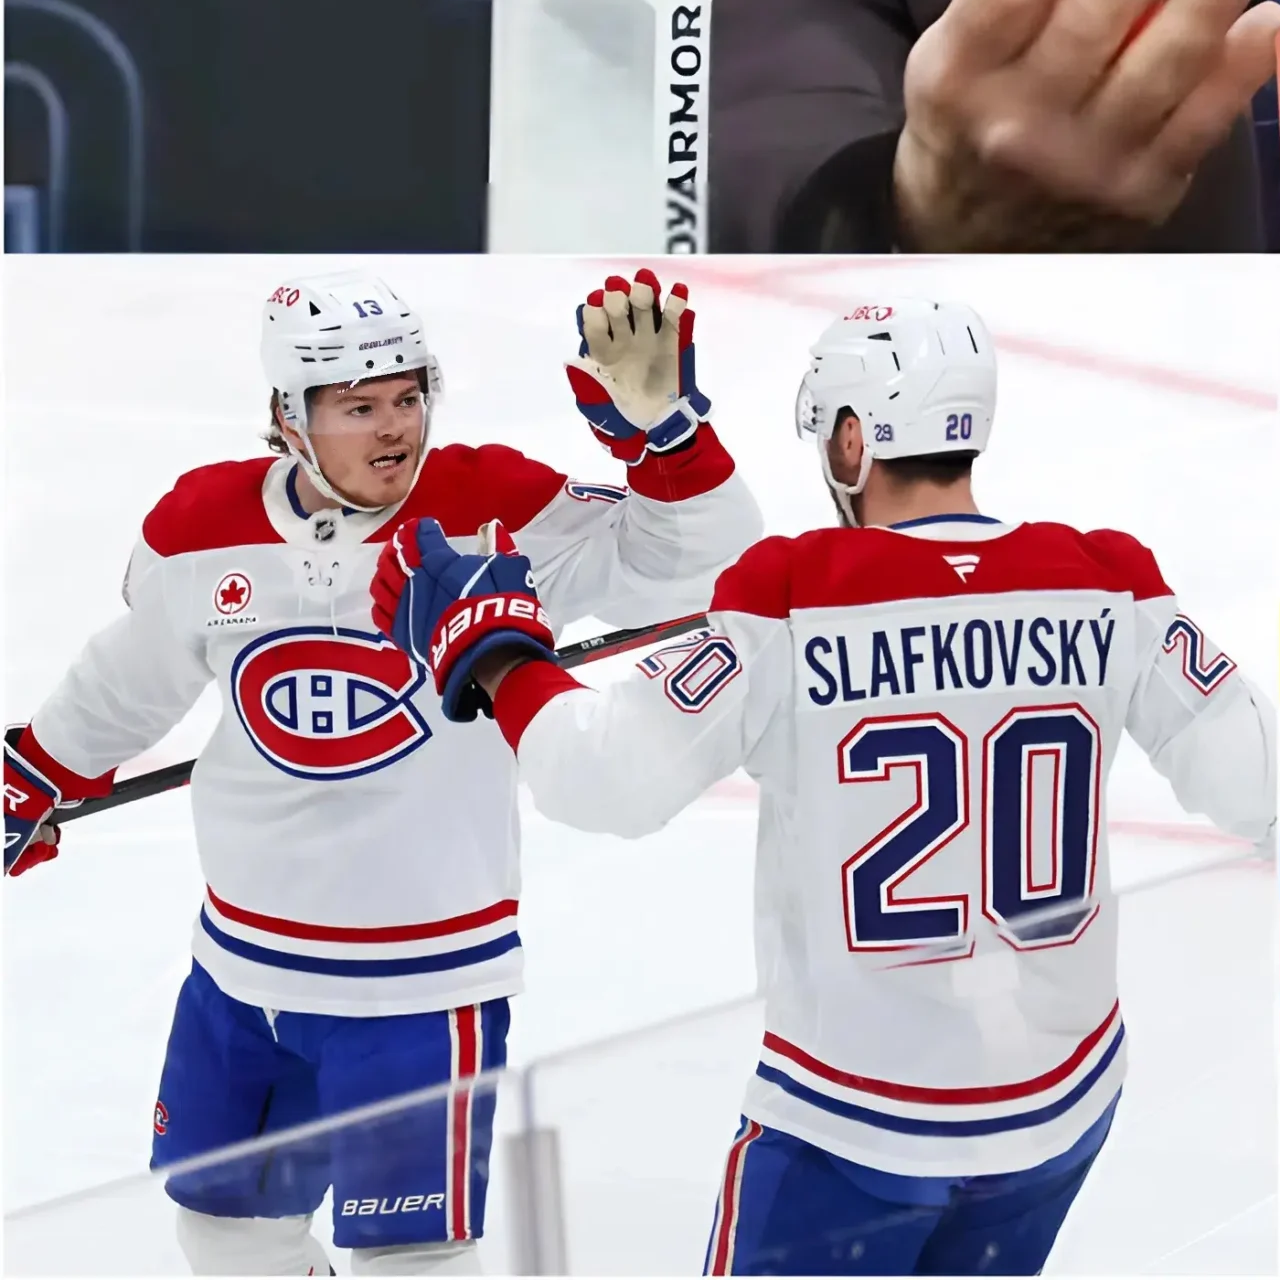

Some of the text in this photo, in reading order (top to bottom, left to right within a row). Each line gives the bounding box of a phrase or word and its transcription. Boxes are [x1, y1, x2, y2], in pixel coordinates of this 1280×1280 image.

[352, 299, 384, 319] 13
[945, 413, 972, 441] 20
[804, 608, 1115, 707] SLAFKOVSKÝ
[836, 702, 1102, 962] 20
